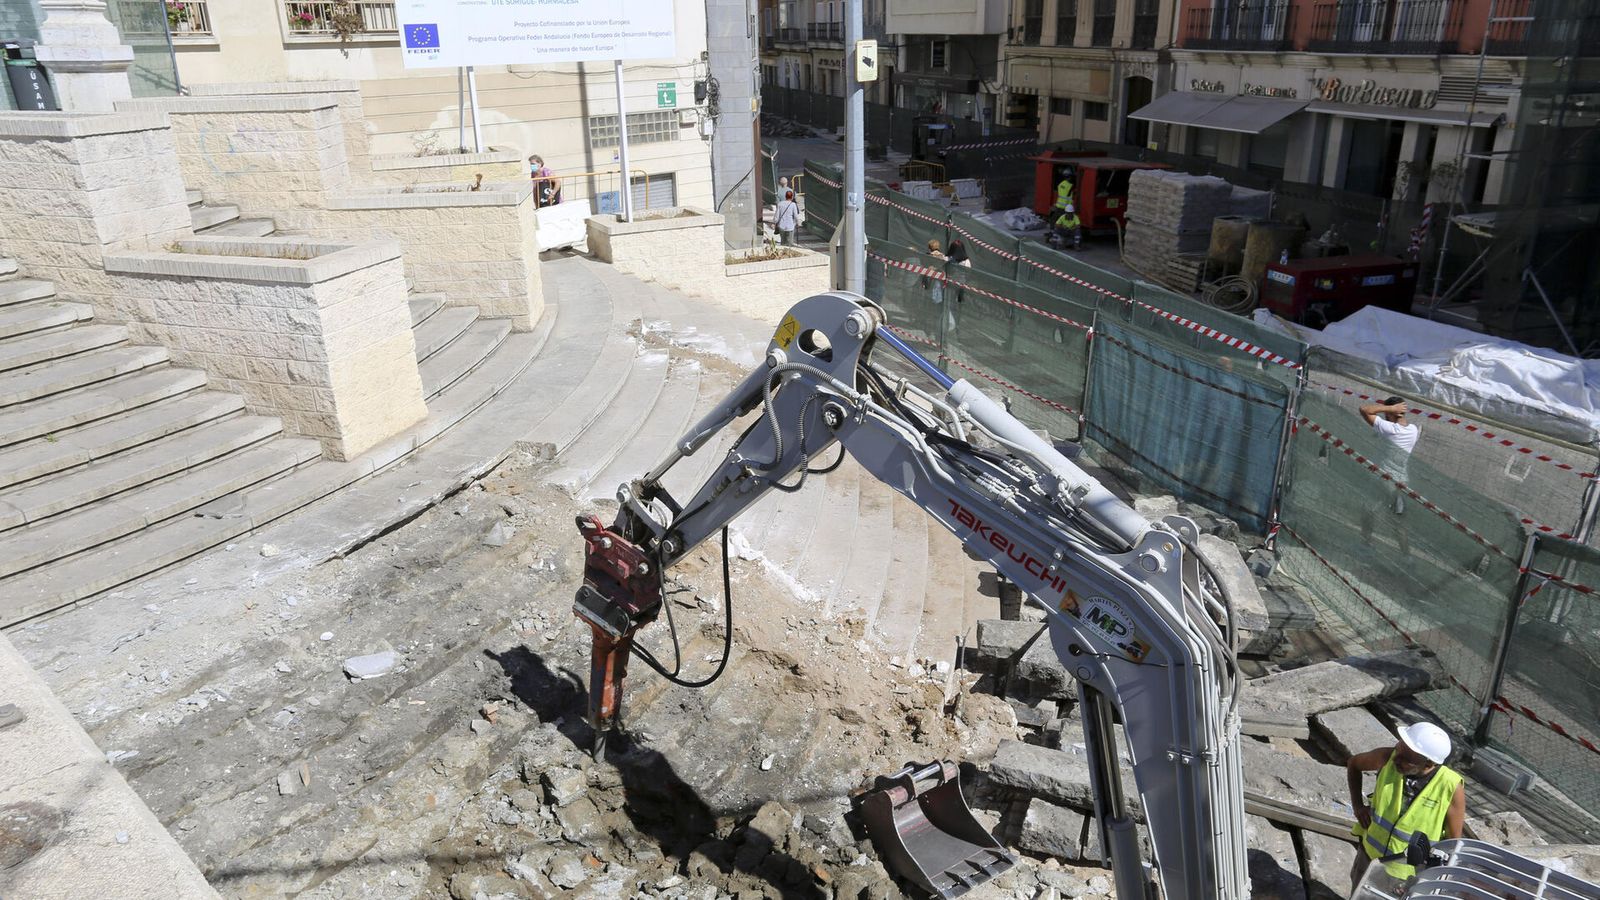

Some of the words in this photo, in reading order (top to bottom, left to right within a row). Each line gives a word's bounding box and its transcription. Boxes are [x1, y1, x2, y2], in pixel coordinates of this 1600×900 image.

[513, 20, 538, 28] Proyecto
[608, 19, 631, 27] Europea
[467, 35, 497, 43] Programa
[498, 34, 526, 42] Operativo
